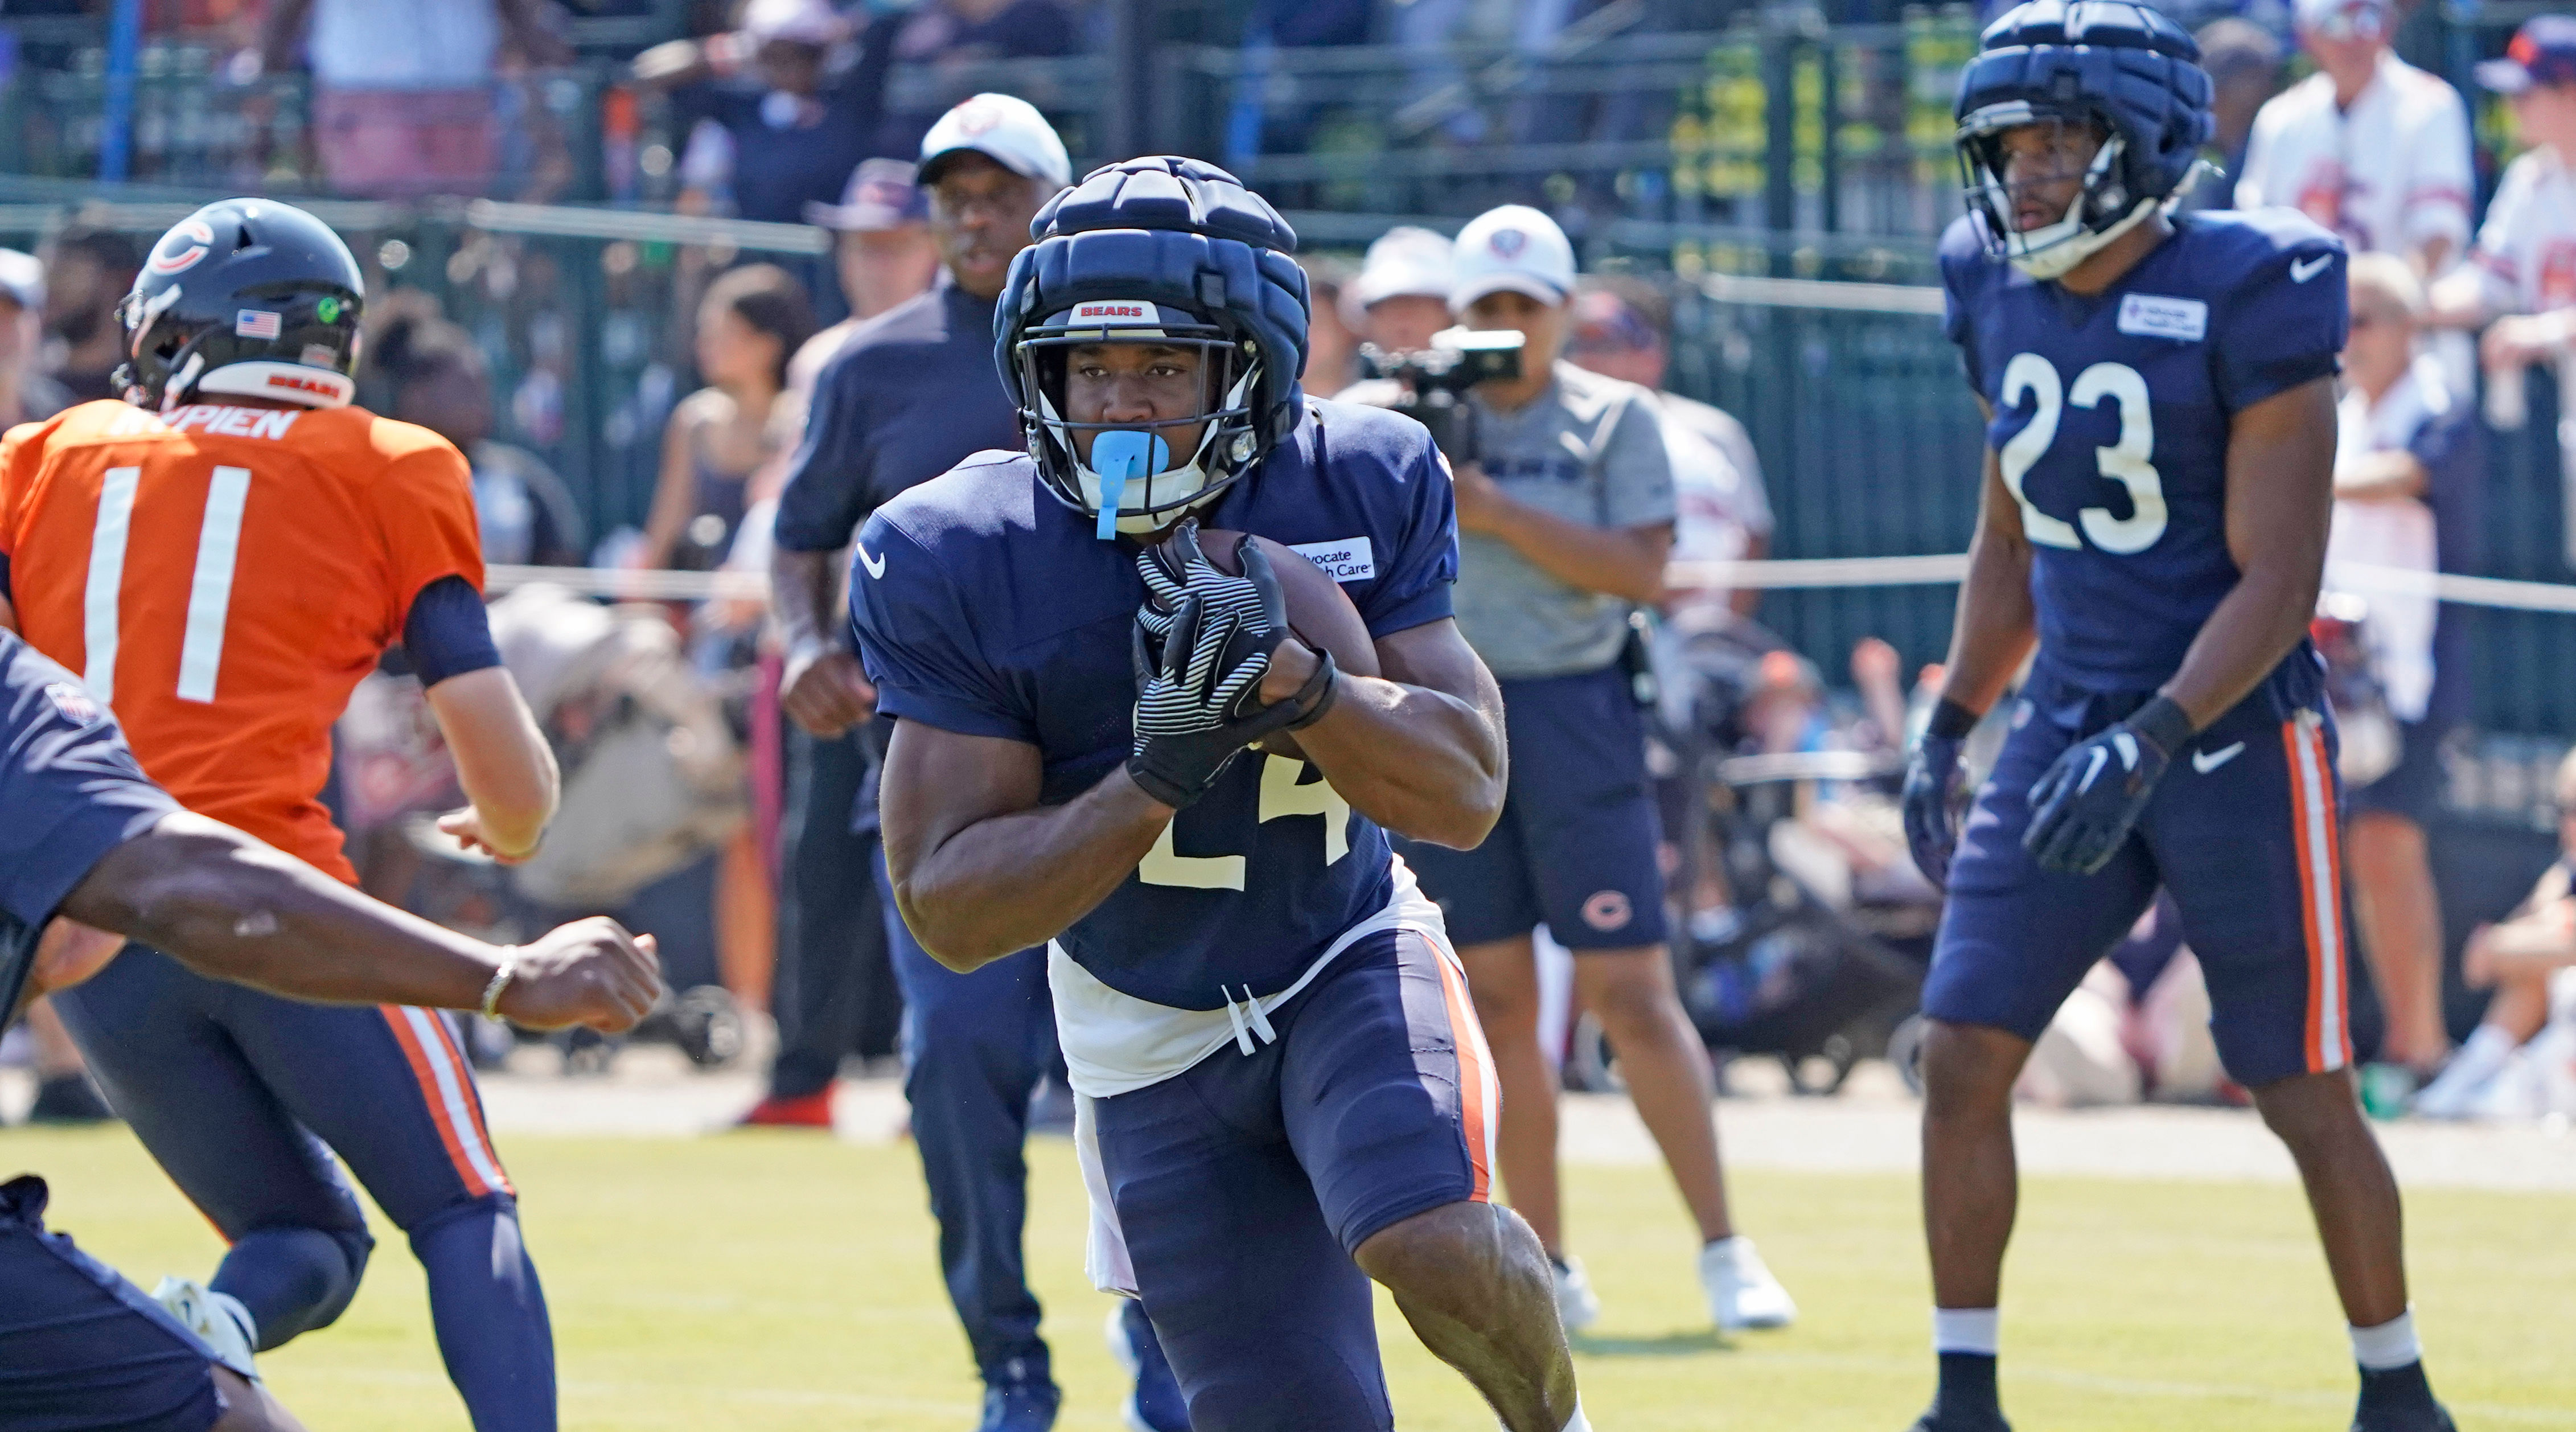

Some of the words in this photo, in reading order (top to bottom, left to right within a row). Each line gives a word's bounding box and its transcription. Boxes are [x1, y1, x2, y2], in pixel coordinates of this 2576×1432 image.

[1080, 306, 1142, 316] BEARS
[1999, 351, 2168, 555] 23
[83, 464, 252, 704] 11
[1337, 564, 1369, 577] Care
